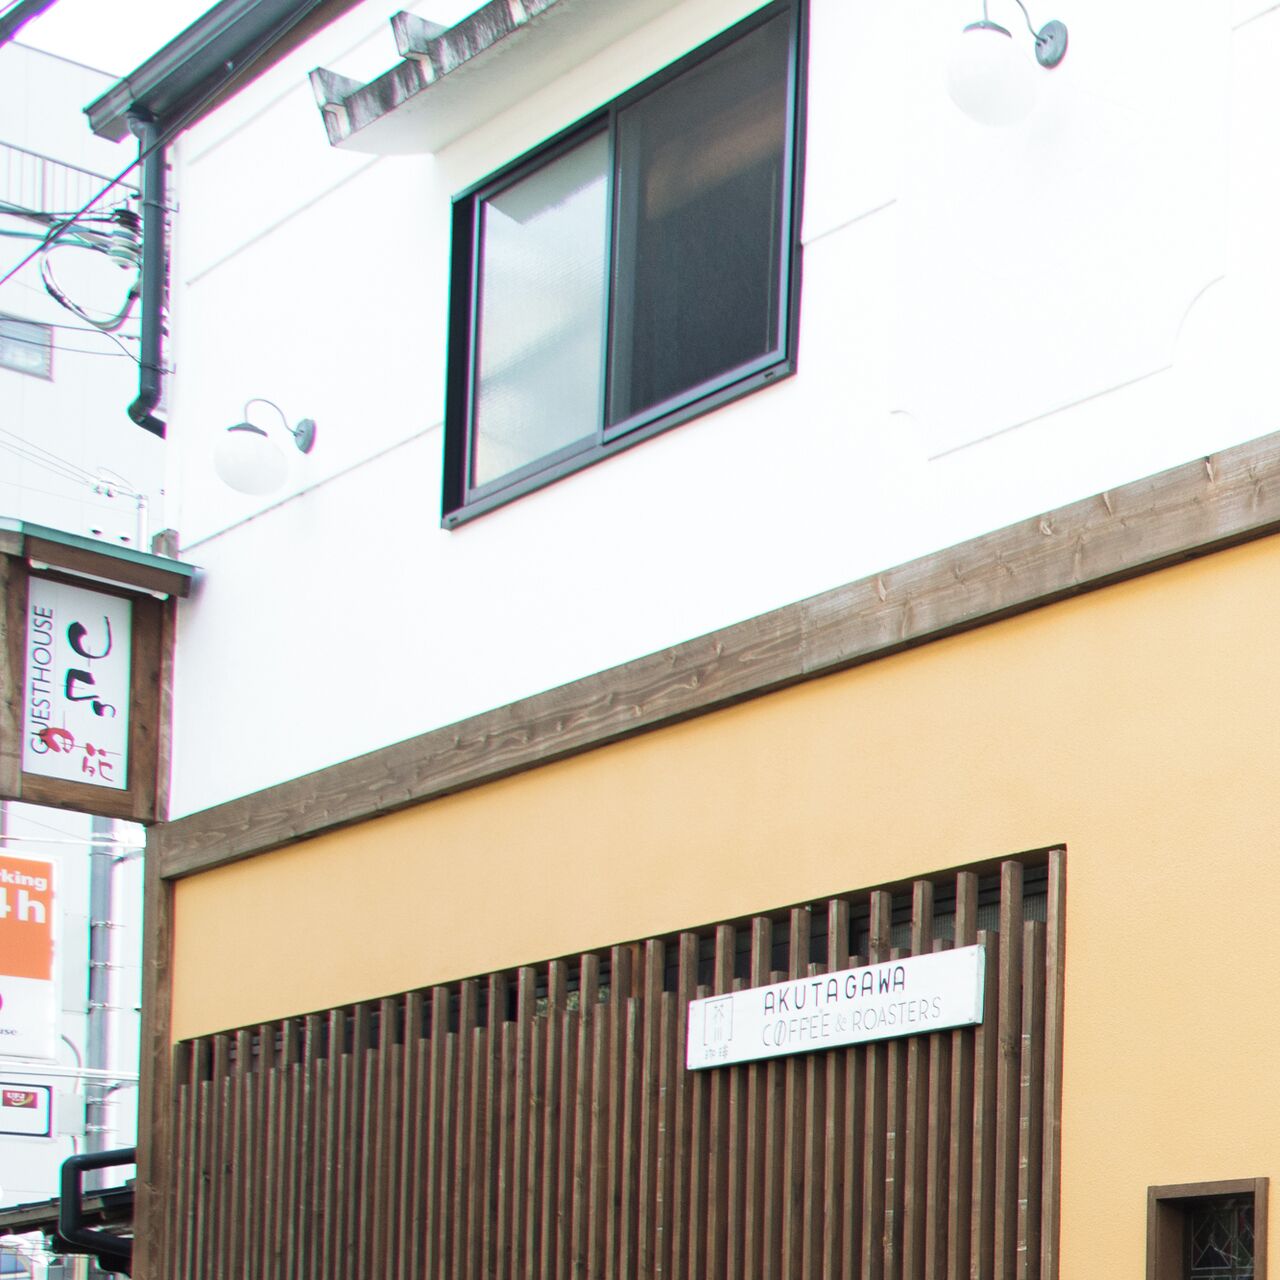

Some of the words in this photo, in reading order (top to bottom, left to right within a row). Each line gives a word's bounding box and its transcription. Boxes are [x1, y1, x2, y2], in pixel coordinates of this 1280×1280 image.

[30, 605, 54, 754] GUESTHOUSE
[764, 966, 905, 1016] AKUTAGAWA
[762, 1012, 830, 1047] COFFEE
[853, 997, 942, 1032] ROASTERS
